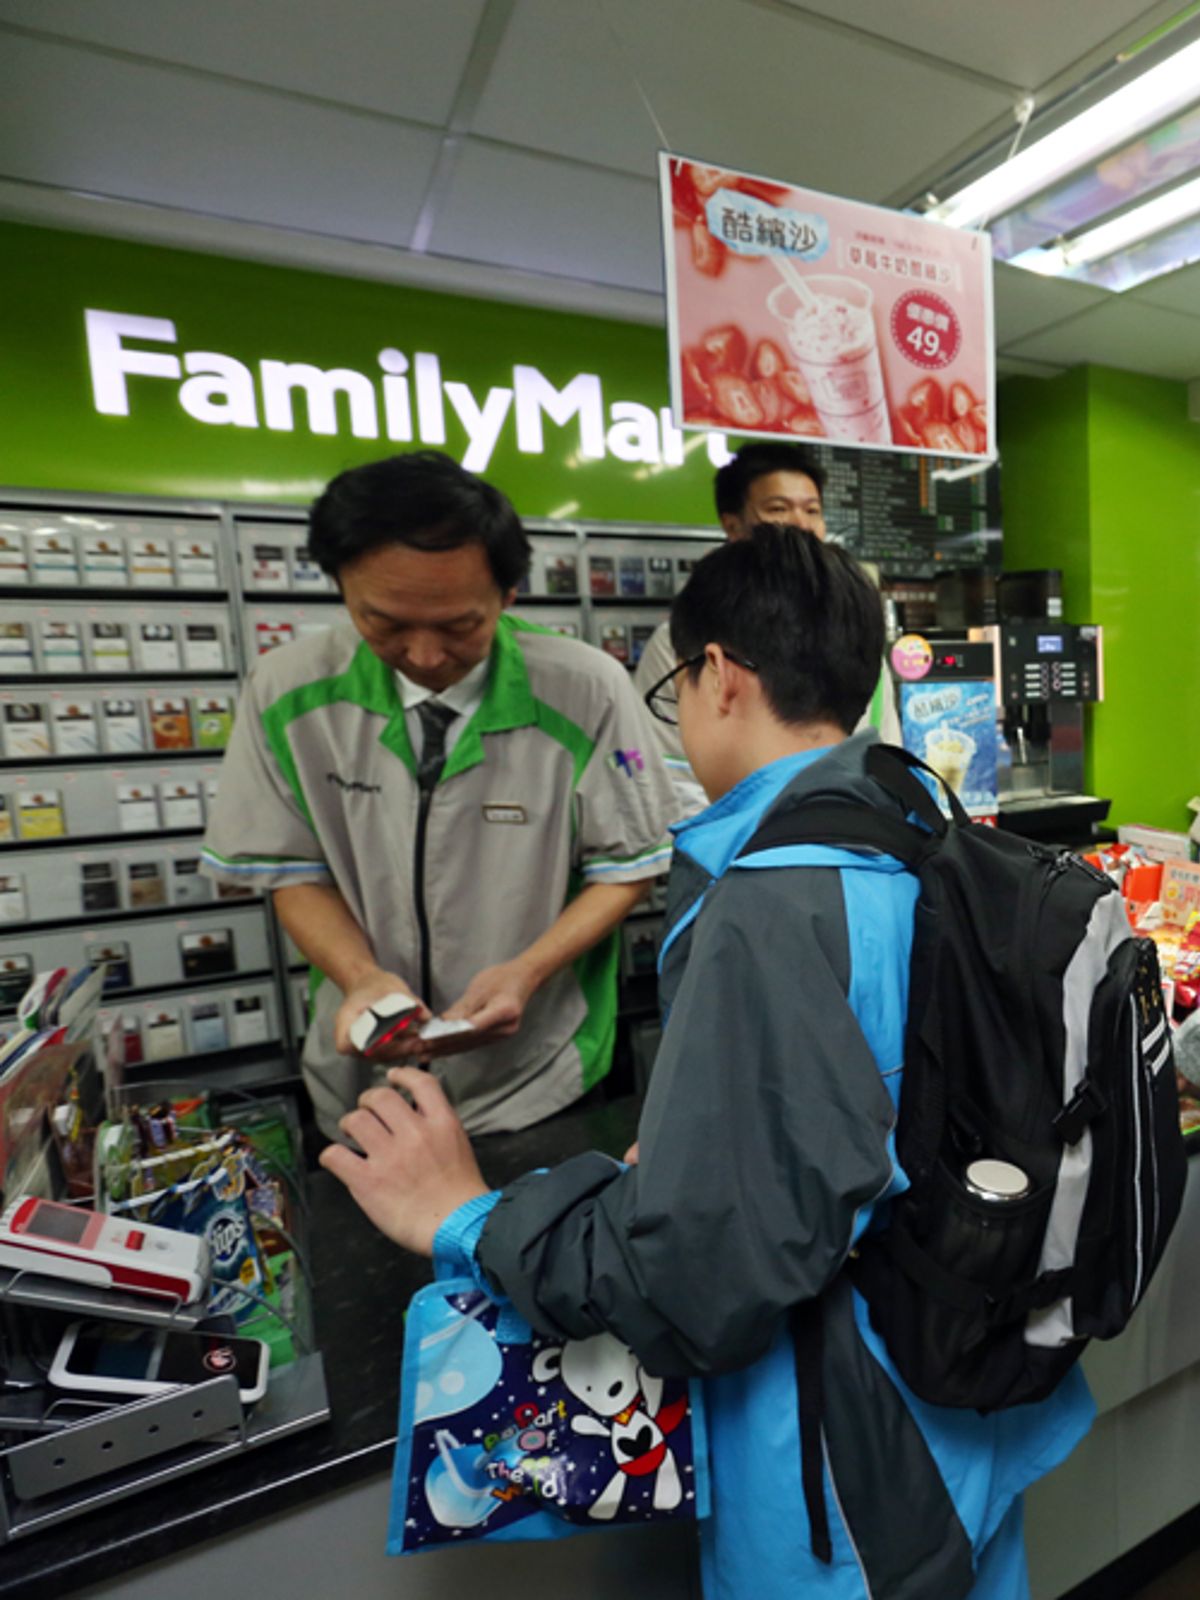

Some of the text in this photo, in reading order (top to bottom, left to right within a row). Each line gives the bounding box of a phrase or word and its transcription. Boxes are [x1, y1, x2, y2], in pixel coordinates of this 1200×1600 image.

[721, 206, 818, 253] 酷繽沙
[906, 325, 940, 356] 49
[514, 1400, 567, 1430] Part
[485, 1460, 525, 1484] The
